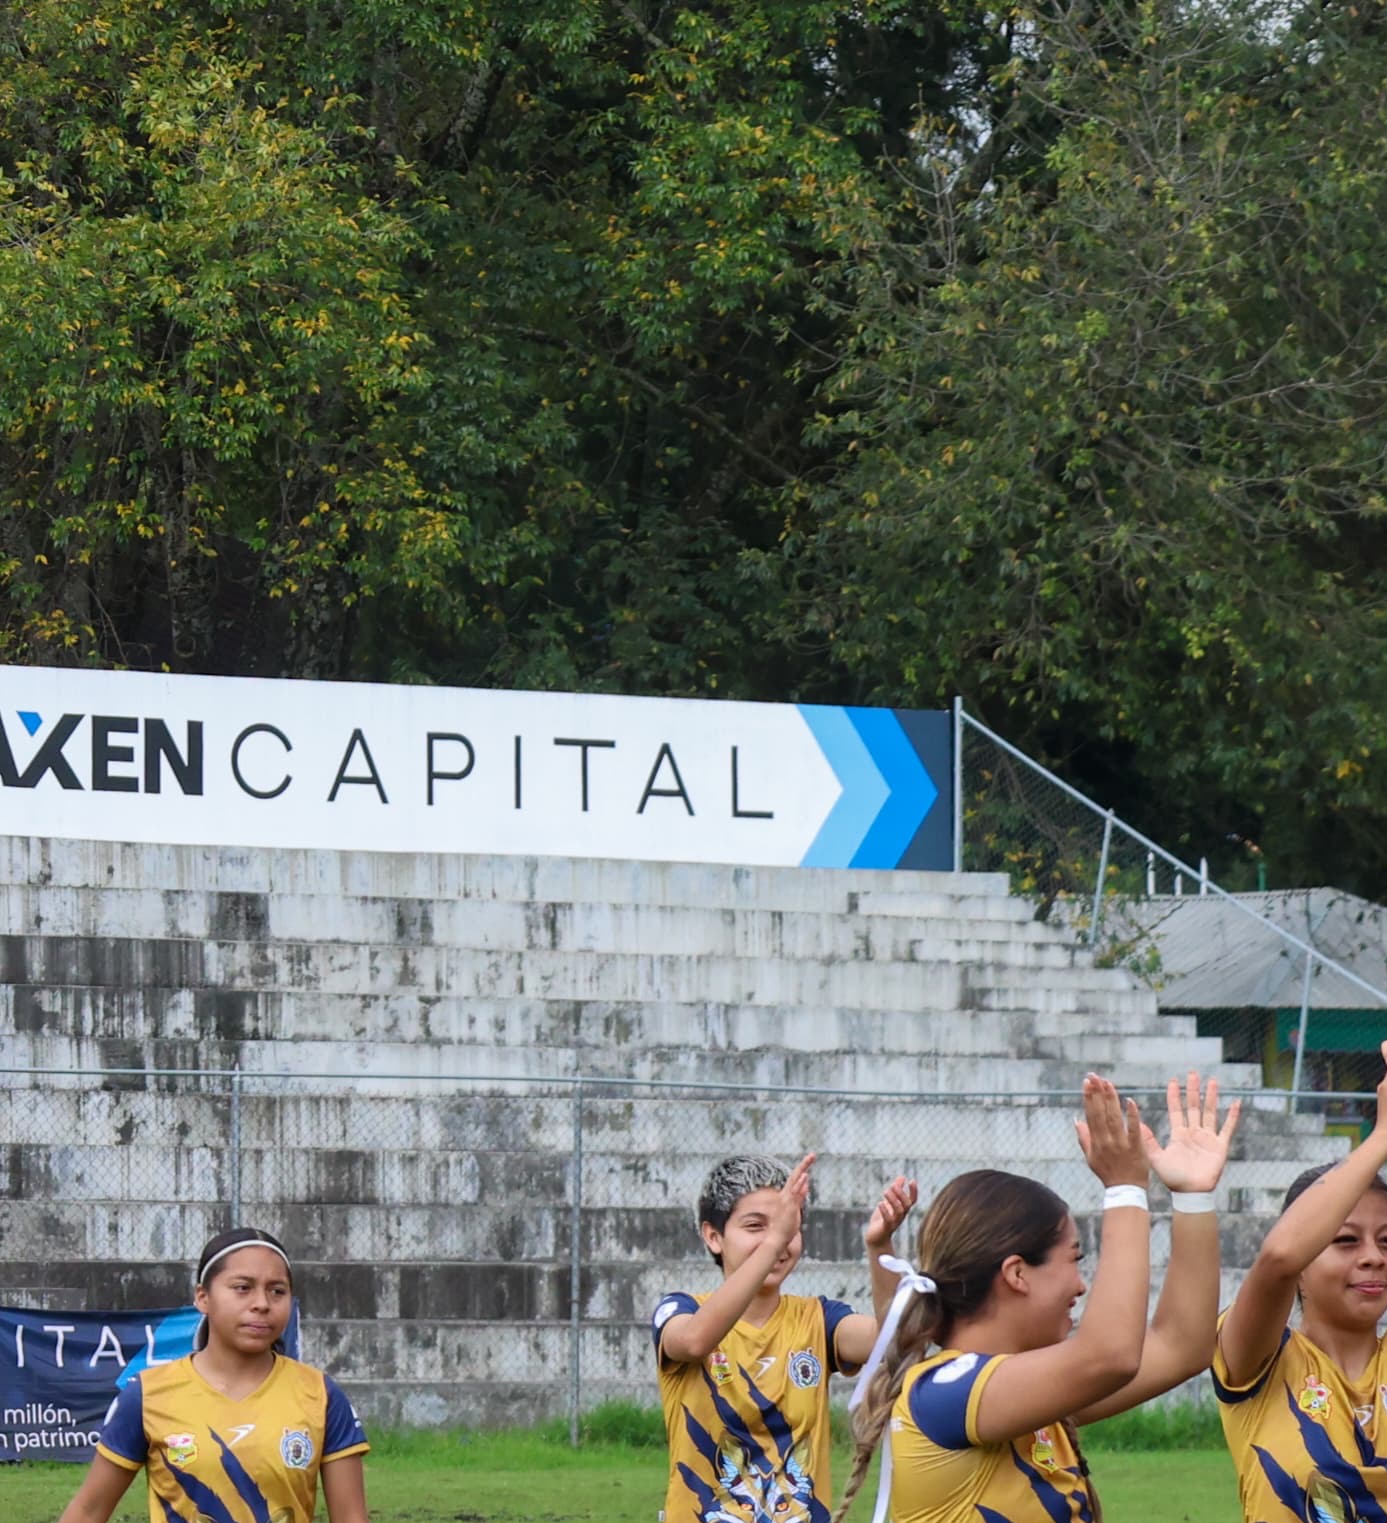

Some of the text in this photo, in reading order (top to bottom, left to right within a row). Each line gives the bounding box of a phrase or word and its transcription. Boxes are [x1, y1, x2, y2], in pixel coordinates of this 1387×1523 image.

[0, 710, 774, 819] XEN CAPITAL
[4, 1402, 77, 1427] millón,
